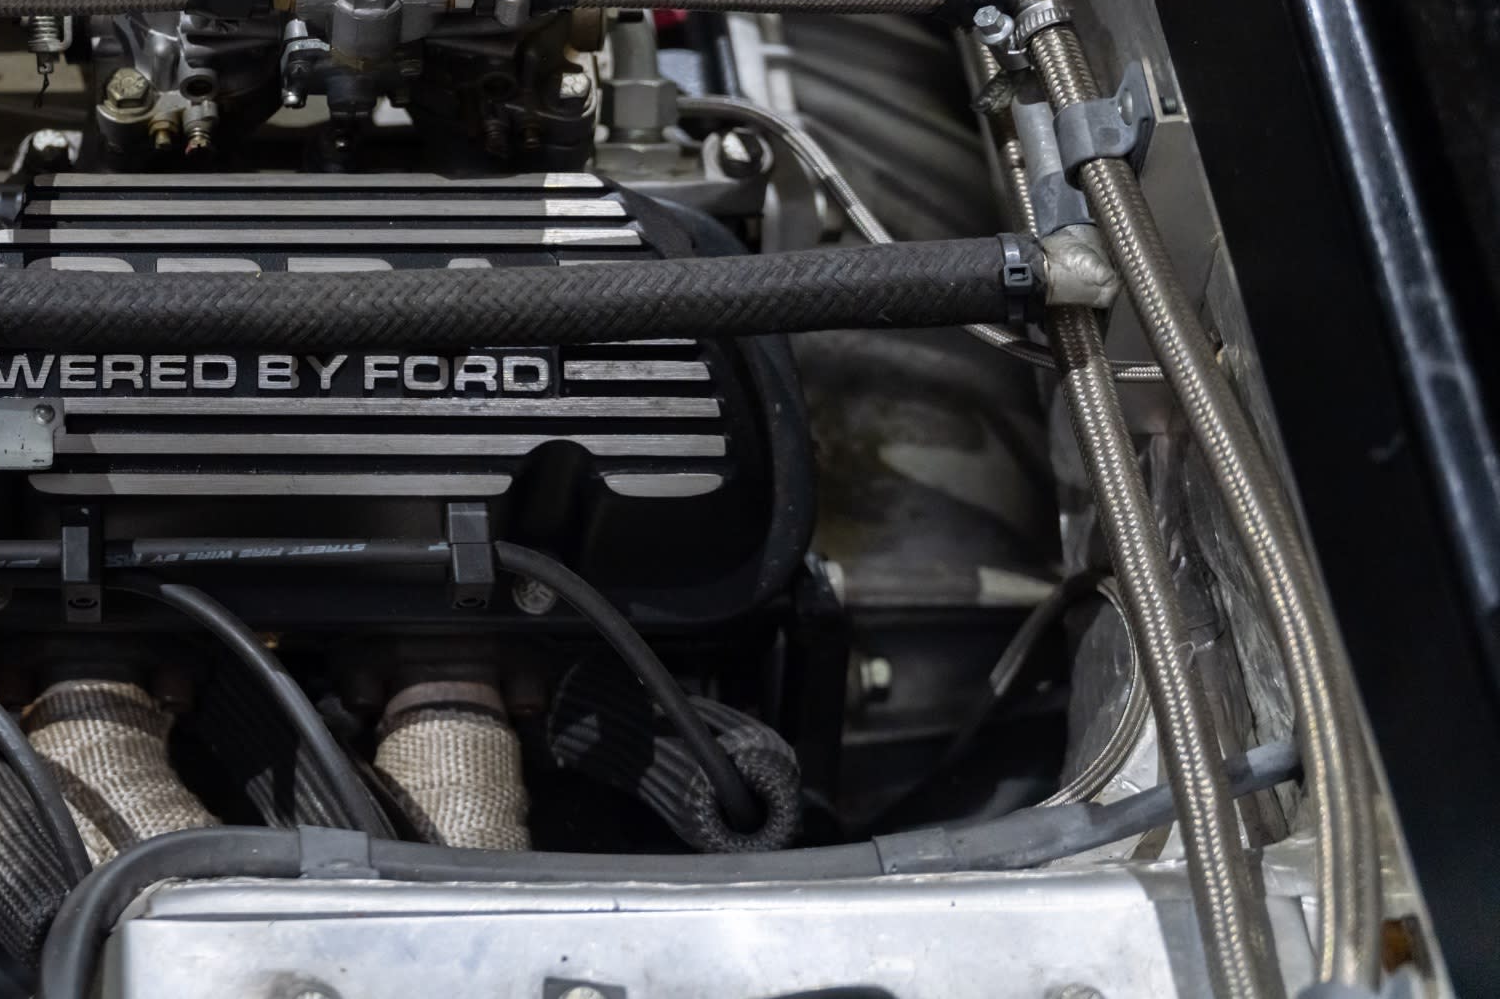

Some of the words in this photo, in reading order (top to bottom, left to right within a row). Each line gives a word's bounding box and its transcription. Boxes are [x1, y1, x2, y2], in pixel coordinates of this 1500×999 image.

[258, 354, 348, 390] BY
[364, 355, 550, 392] FORD
[184, 549, 235, 561] WIRE
[238, 547, 285, 559] FIRE
[288, 543, 367, 556] STREET
[150, 552, 181, 563] BY
